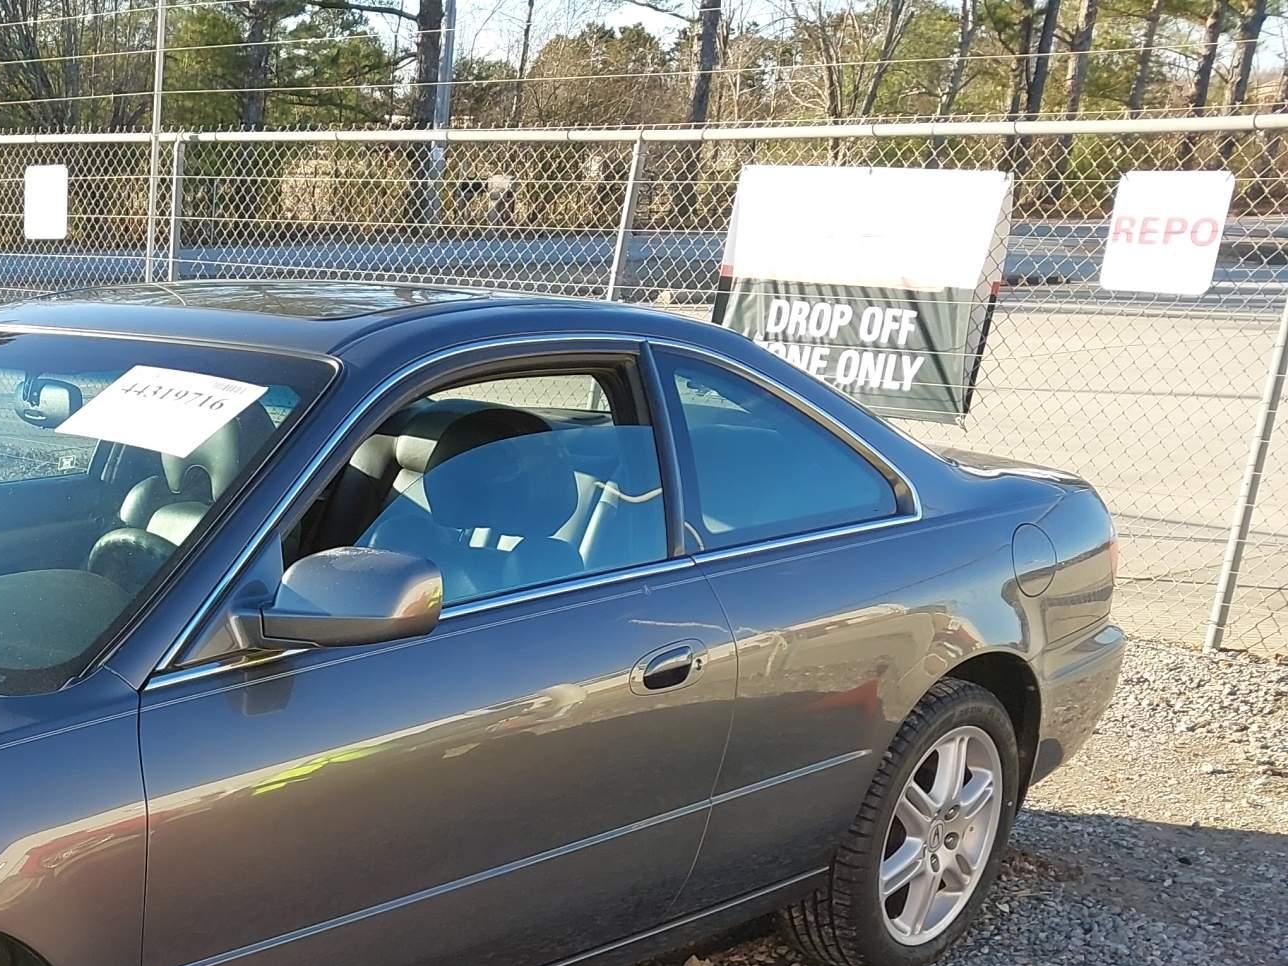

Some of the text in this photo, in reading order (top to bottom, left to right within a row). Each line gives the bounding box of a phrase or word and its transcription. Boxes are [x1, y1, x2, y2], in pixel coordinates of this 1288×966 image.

[1112, 215, 1219, 247] REPO
[766, 298, 918, 346] DROP OFF
[836, 348, 925, 392] ONLY
[120, 382, 228, 411] 44319716
